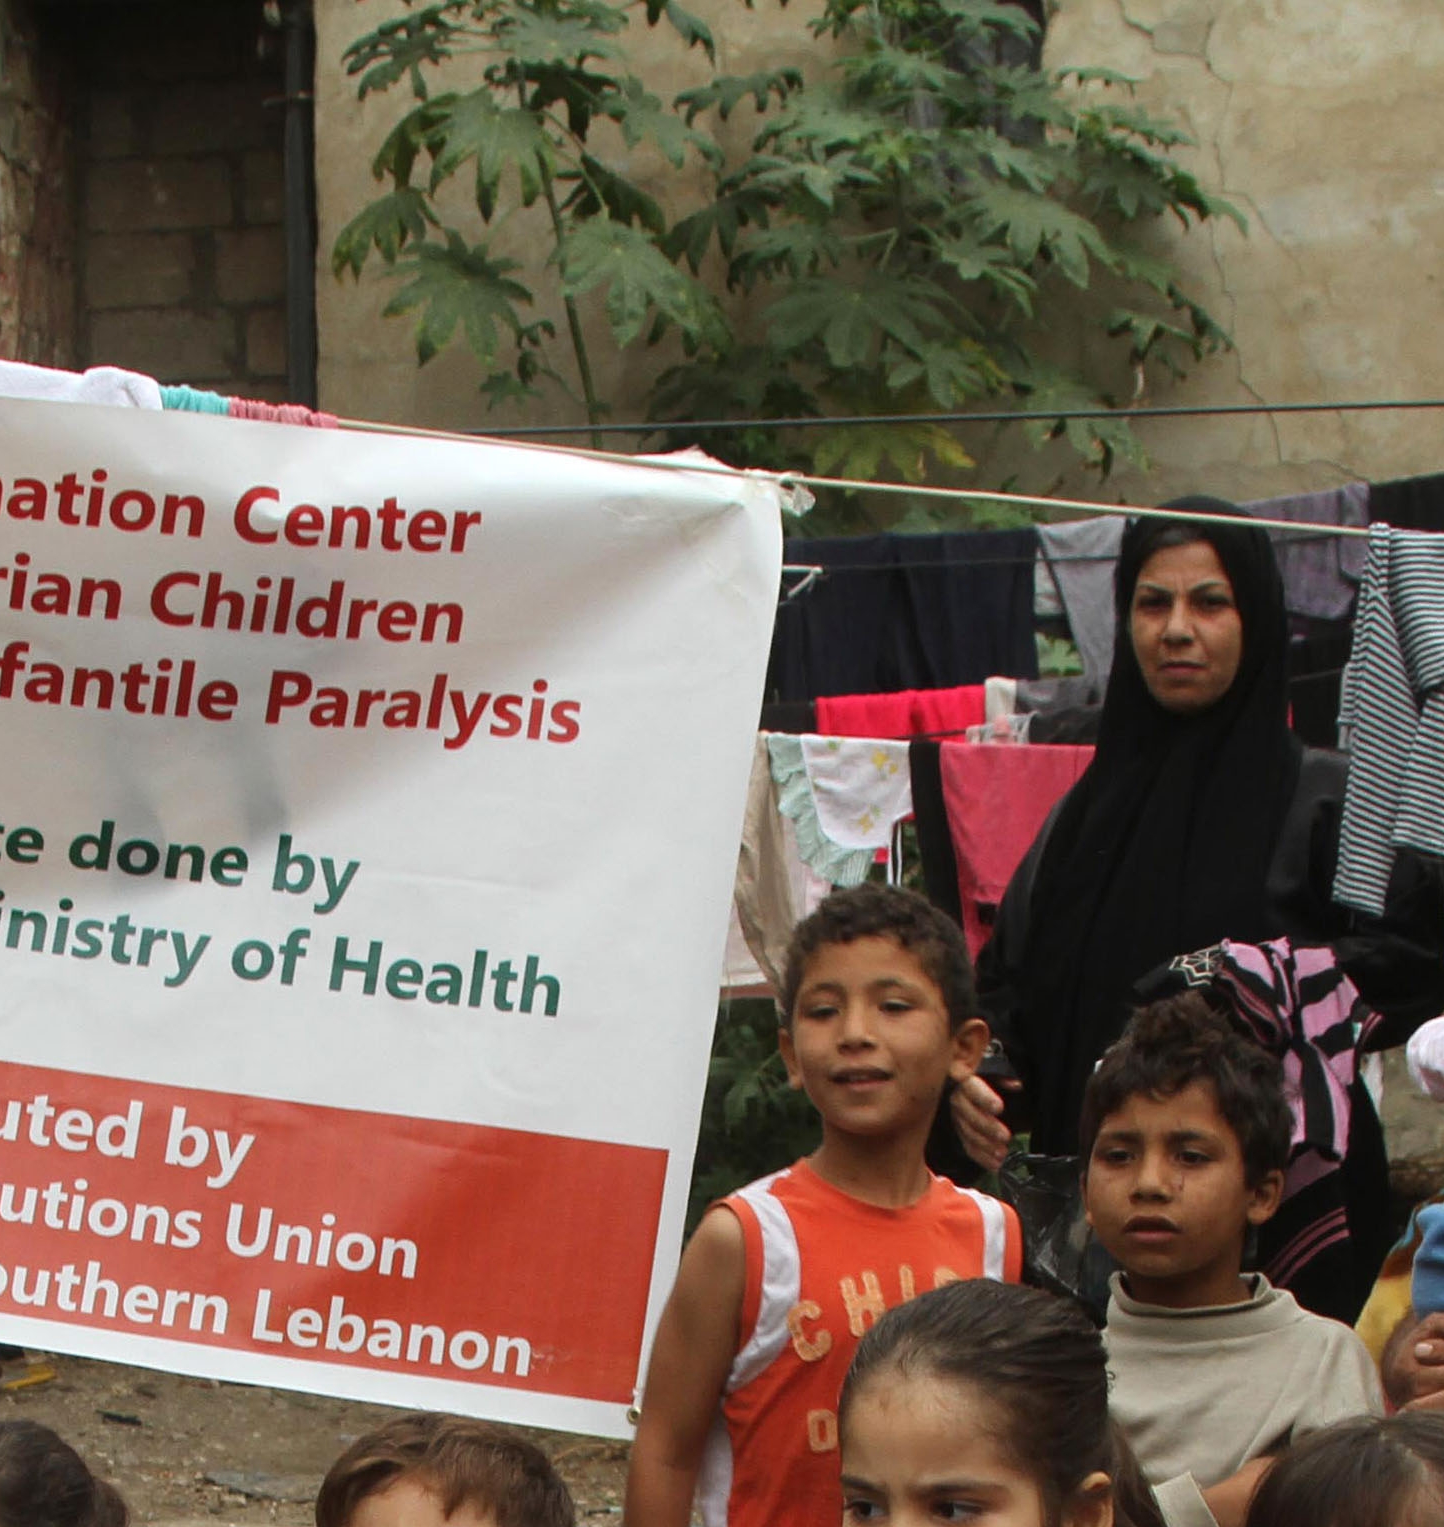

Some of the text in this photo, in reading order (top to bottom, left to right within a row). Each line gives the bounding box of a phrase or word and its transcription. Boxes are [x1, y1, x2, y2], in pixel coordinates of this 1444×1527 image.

[235, 488, 481, 553] Center
[153, 574, 463, 643] Children
[267, 674, 580, 750] Paralysis
[68, 820, 248, 886] done
[272, 834, 361, 915] by
[231, 928, 311, 986] of
[329, 936, 560, 1018] Health
[165, 1106, 255, 1188] by
[226, 1203, 417, 1278] Union
[252, 1289, 530, 1376] Lebanon
